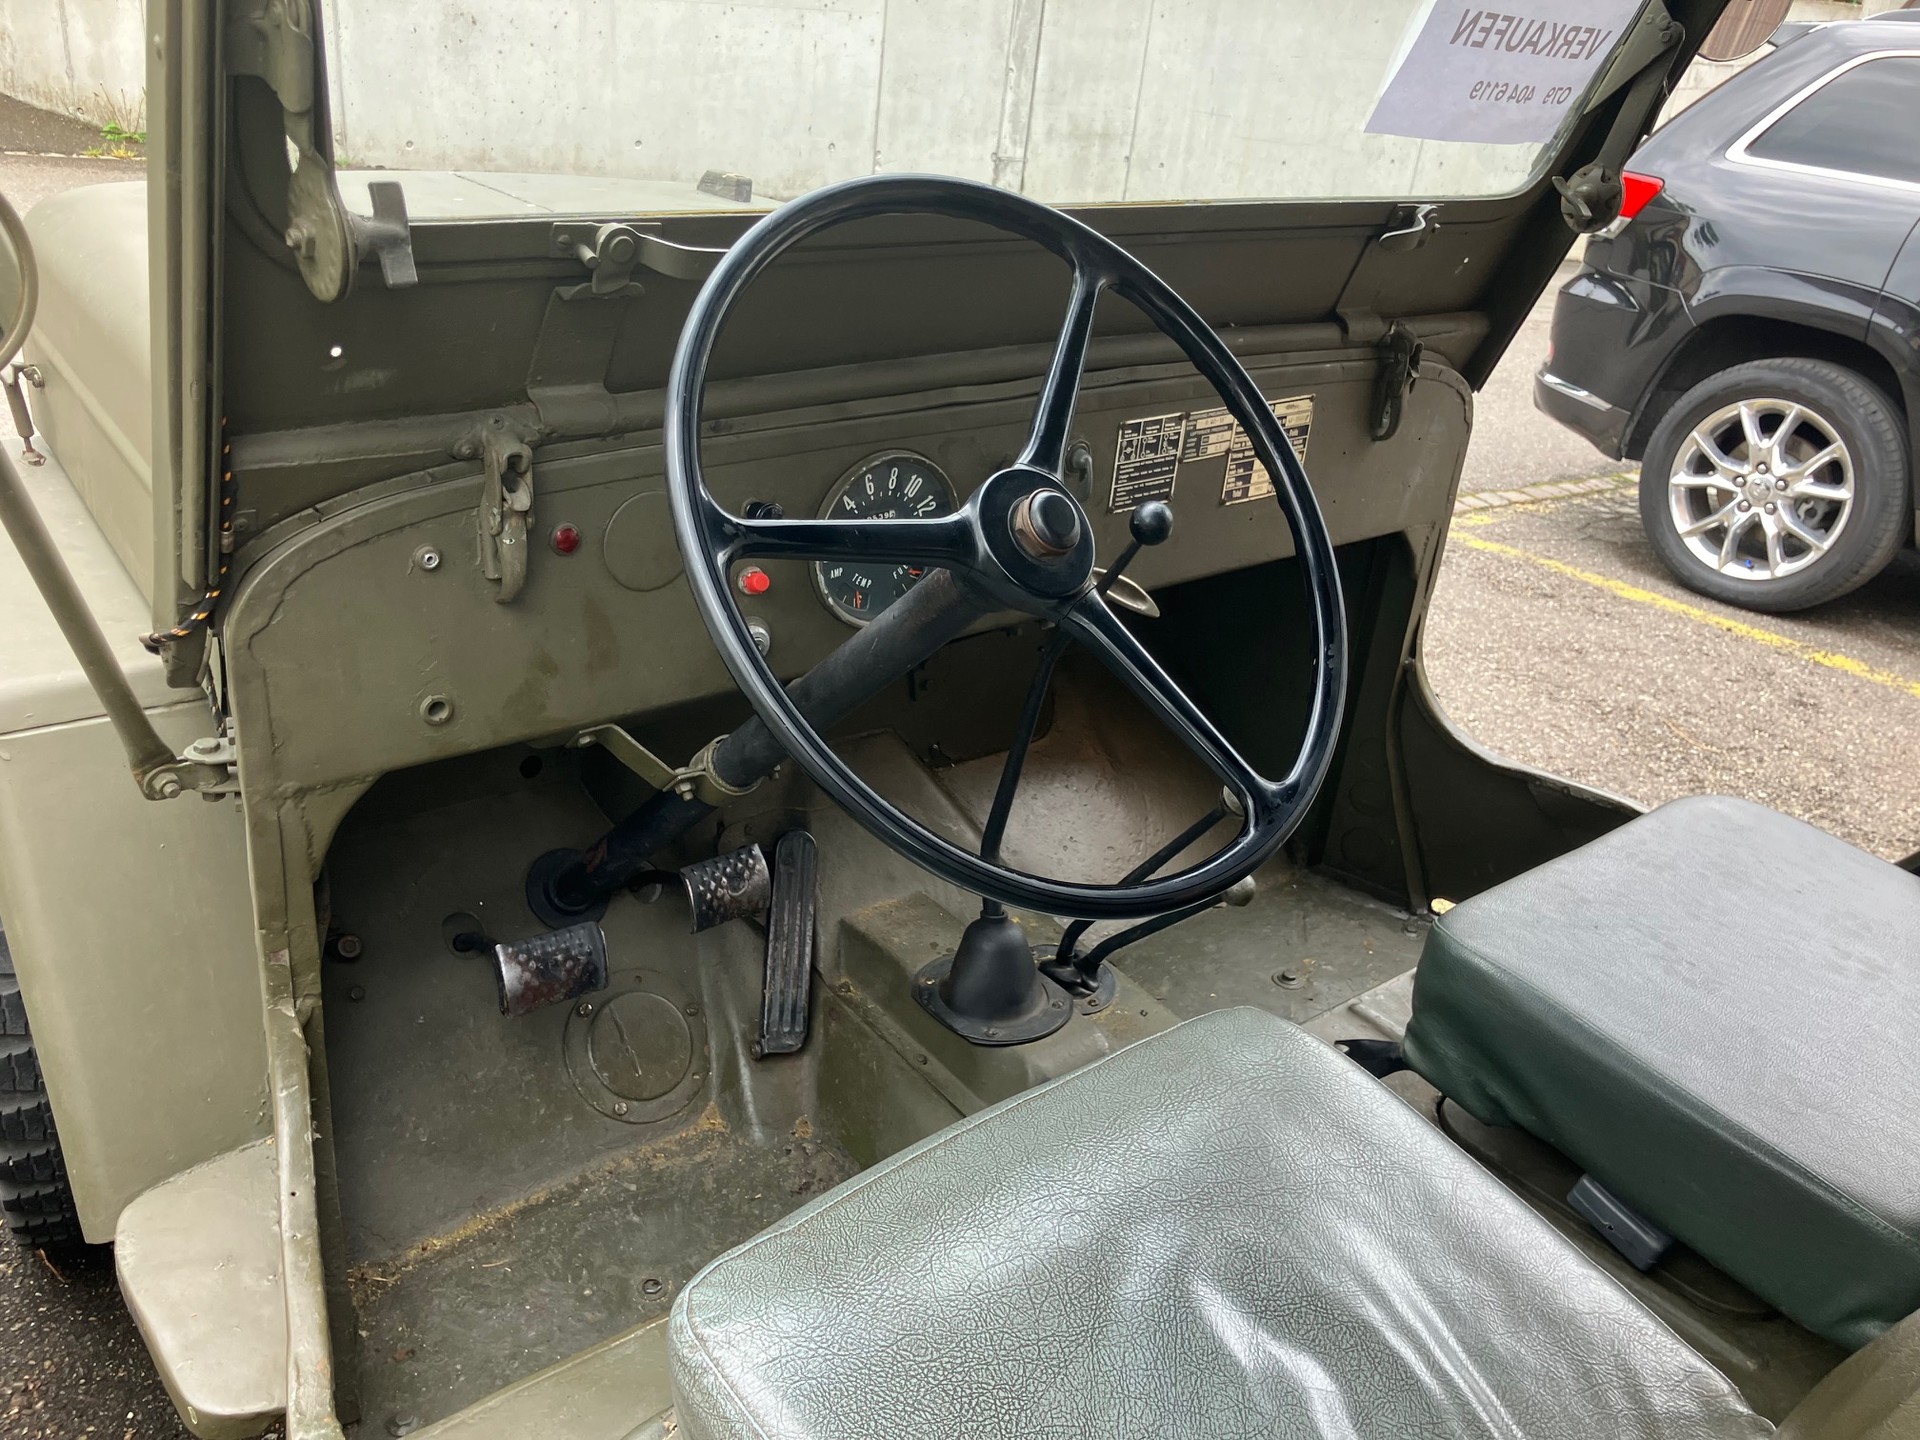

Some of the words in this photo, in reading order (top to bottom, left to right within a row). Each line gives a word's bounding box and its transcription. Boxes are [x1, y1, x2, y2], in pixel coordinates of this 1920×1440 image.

[865, 473, 875, 495] 6
[888, 467, 899, 490] 8
[904, 474, 923, 498] 10
[843, 494, 857, 512] 4
[917, 494, 938, 518] 12
[830, 567, 844, 579] AMP
[852, 573, 873, 589] TEMP
